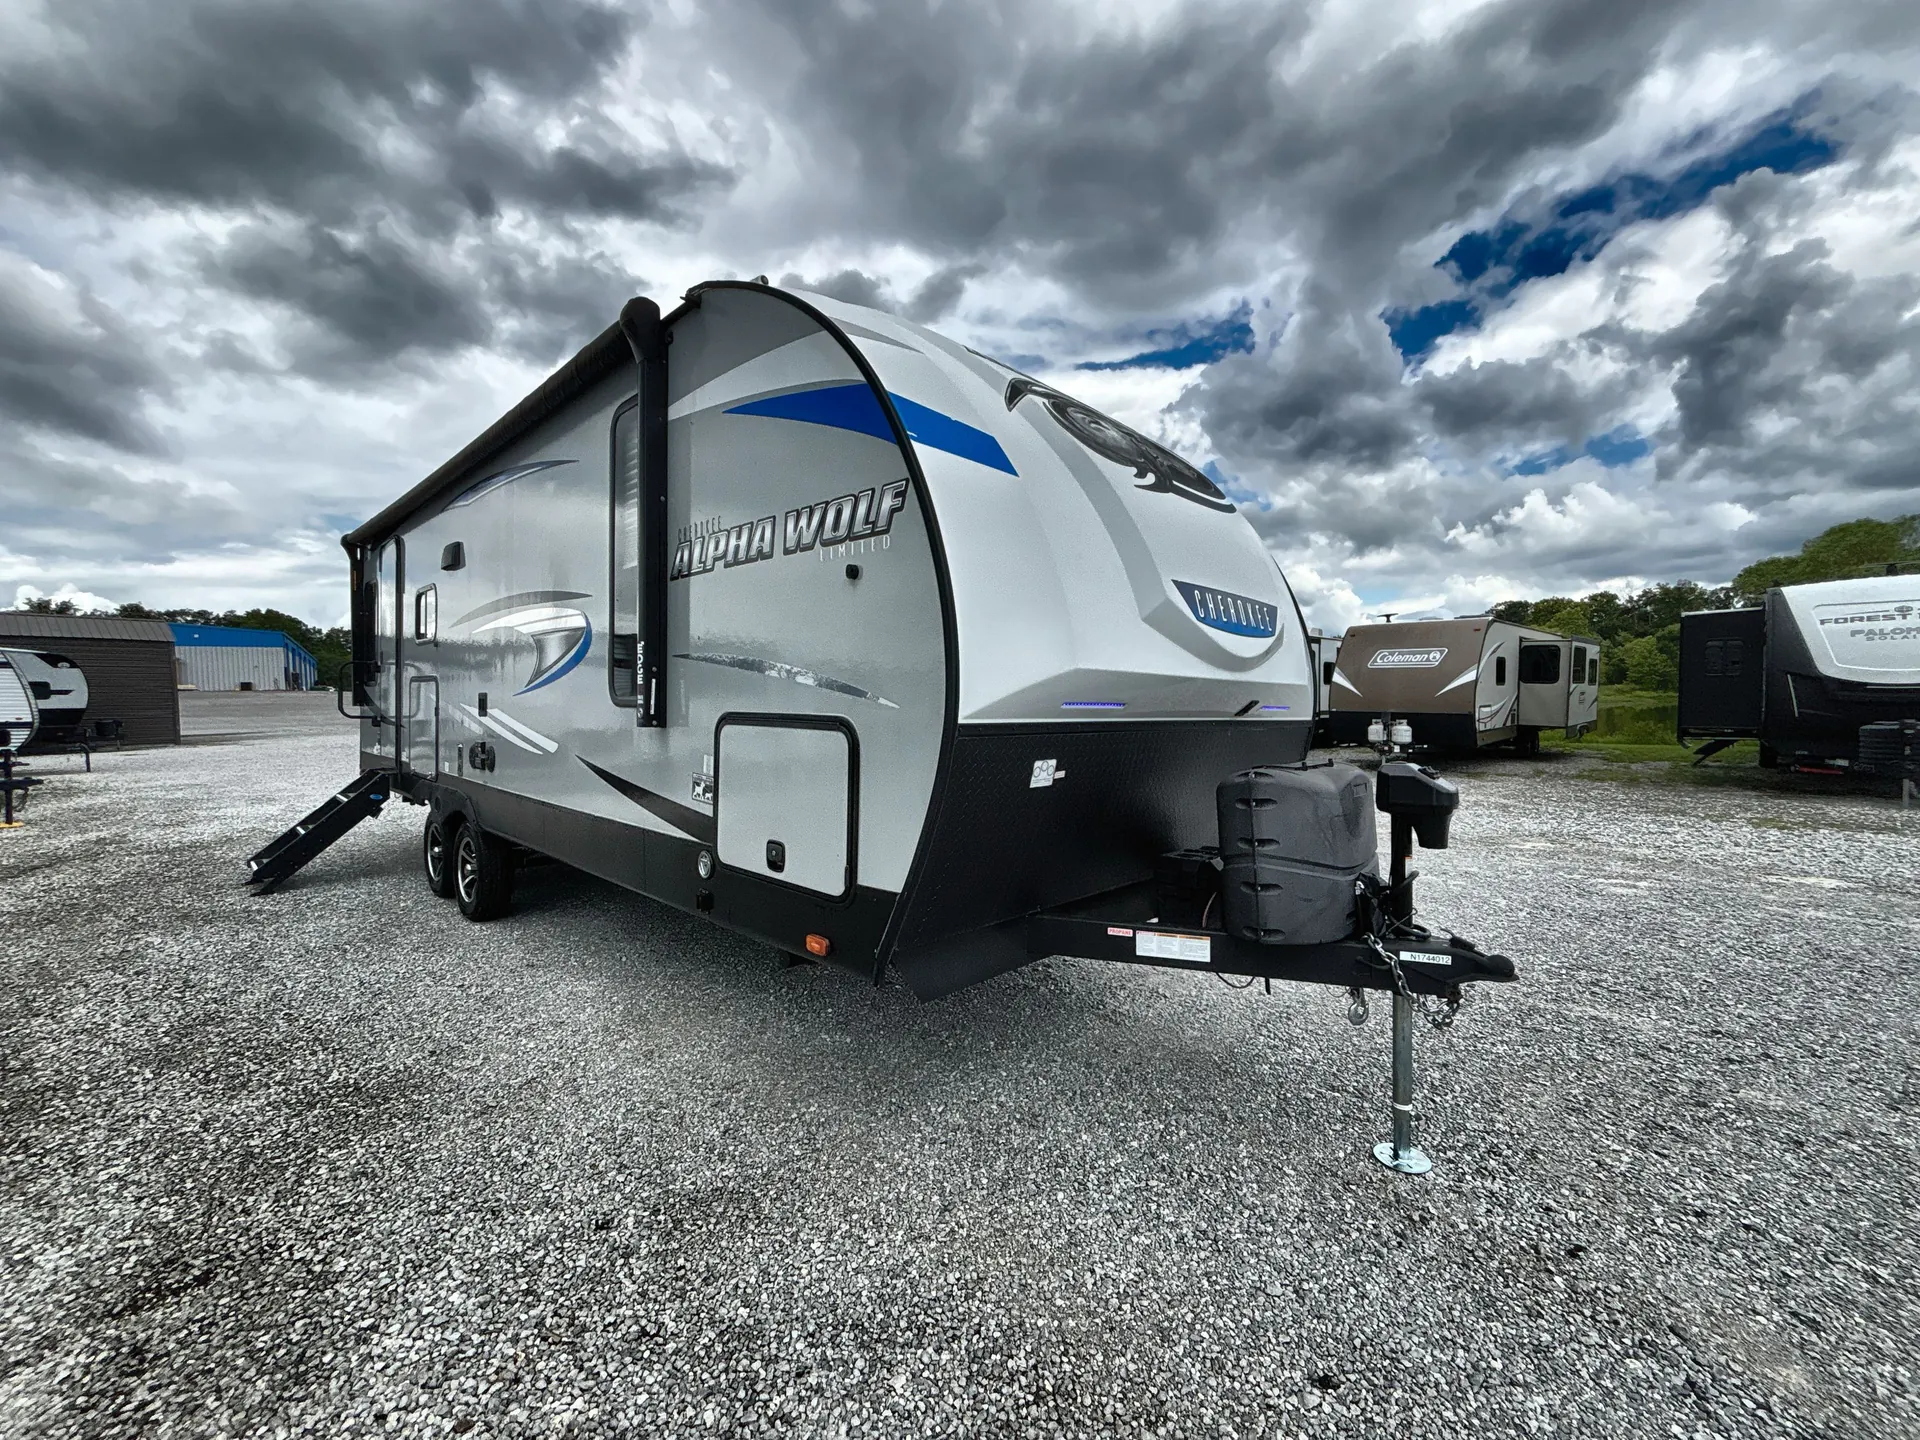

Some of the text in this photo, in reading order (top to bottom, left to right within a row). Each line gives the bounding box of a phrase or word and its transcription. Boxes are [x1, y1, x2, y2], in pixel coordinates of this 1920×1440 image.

[670, 477, 910, 582] ALPHA WOLF
[819, 535, 891, 562] LIMITED
[1194, 589, 1273, 632] CHEROKEE
[1819, 612, 1912, 625] FOREST
[1376, 651, 1428, 663] Coleman
[1108, 928, 1132, 936] PROPANE
[1410, 953, 1451, 964] N1744012
